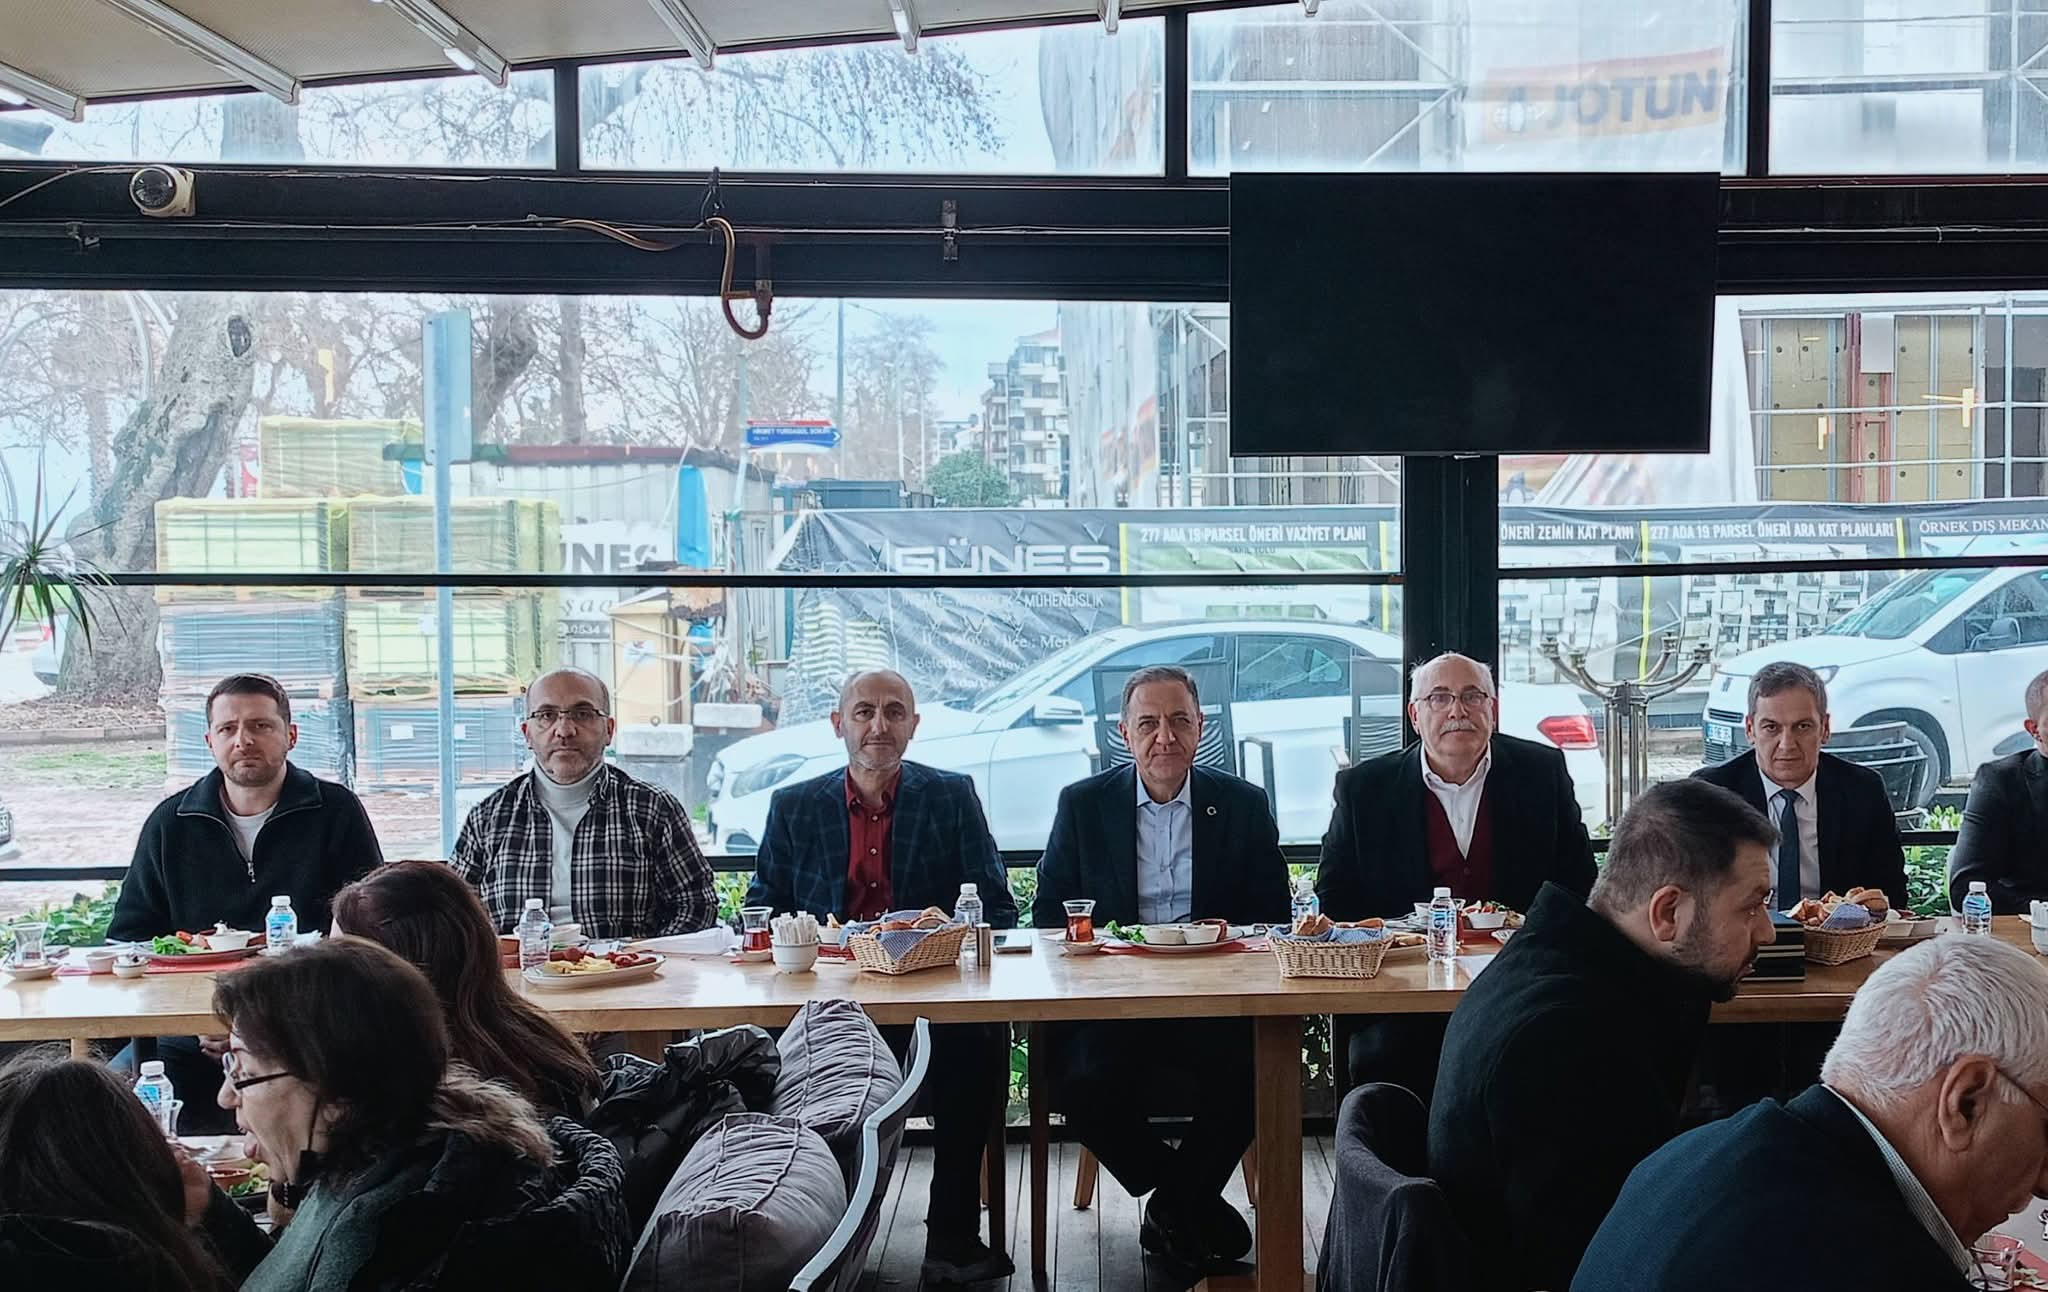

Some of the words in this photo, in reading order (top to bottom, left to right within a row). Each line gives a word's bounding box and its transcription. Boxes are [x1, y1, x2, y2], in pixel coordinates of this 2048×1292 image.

[1547, 66, 1718, 128] JOTUN
[1141, 527, 1160, 543] 277
[1204, 527, 1246, 542] PARSEL
[1248, 524, 1283, 542] ÖNERİ
[1286, 524, 1330, 541] VAZİYET
[1333, 526, 1366, 541] PLANI
[1500, 523, 1534, 540] ÖNERİ
[1538, 524, 1573, 540] ZEMİN
[1577, 526, 1598, 540] KAT
[1672, 525, 1695, 539] ADA
[1697, 525, 1710, 539] 19
[1713, 524, 1755, 538] PARSEL
[1758, 520, 1791, 537] ÖNERİ
[1793, 522, 1816, 537] ARA
[1818, 522, 1839, 537] KAT
[1841, 522, 1894, 537] PLANLARI
[1919, 520, 1969, 534] ÖRNEK
